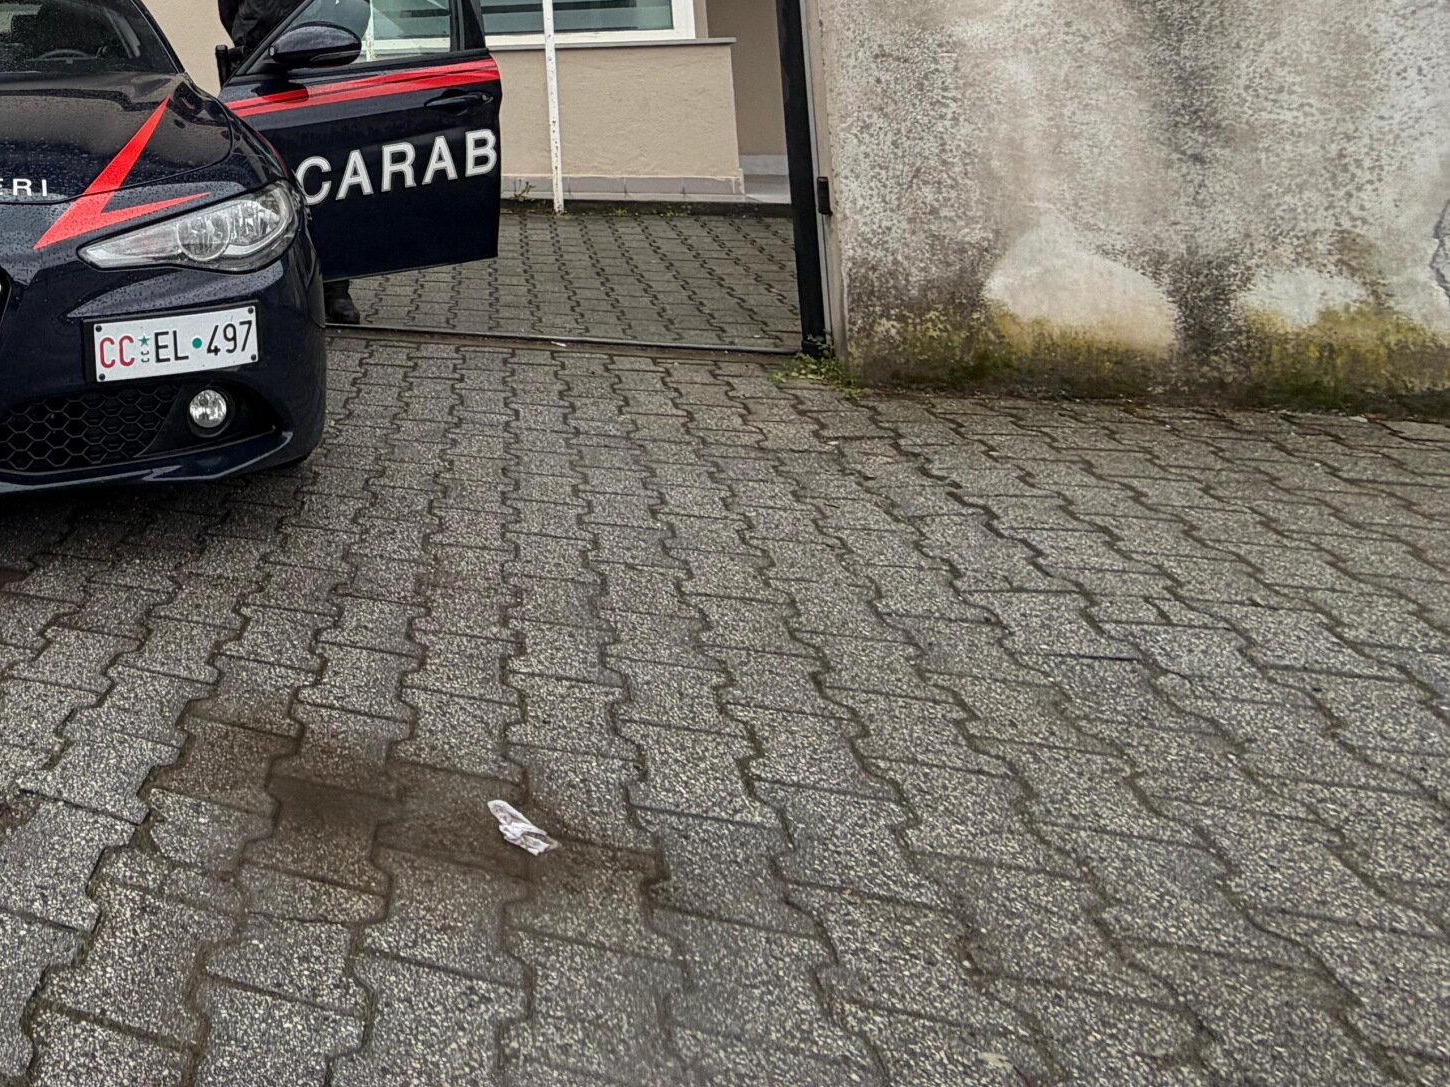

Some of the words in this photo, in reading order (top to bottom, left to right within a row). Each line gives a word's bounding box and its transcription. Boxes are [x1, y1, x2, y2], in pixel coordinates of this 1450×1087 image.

[295, 128, 498, 206] CARAB
[99, 334, 136, 369] CC
[206, 319, 253, 357] 497
